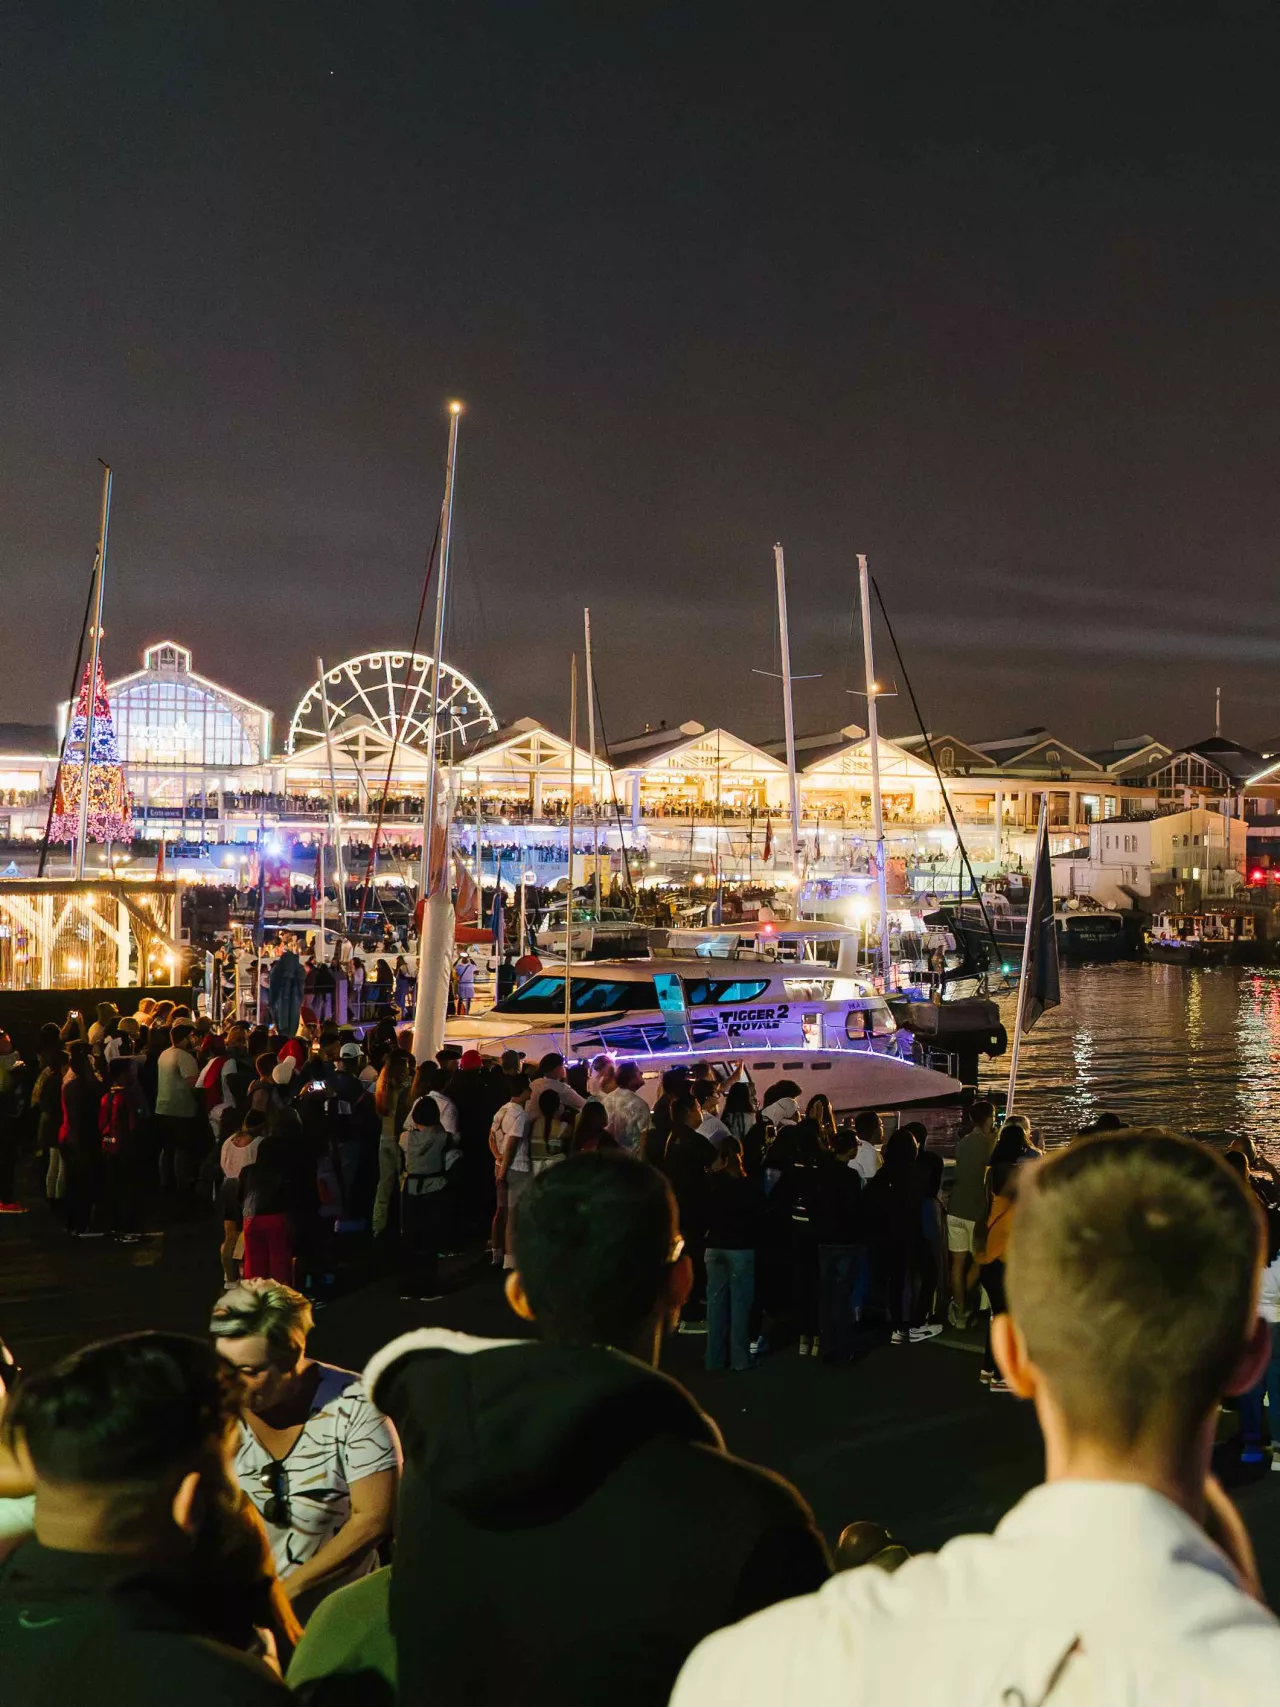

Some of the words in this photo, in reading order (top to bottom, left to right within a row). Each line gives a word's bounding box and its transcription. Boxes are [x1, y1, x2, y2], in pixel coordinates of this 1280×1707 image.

[719, 1009, 775, 1028] TIGGER
[777, 1004, 789, 1019] 2
[727, 1020, 781, 1037] ROYALE
